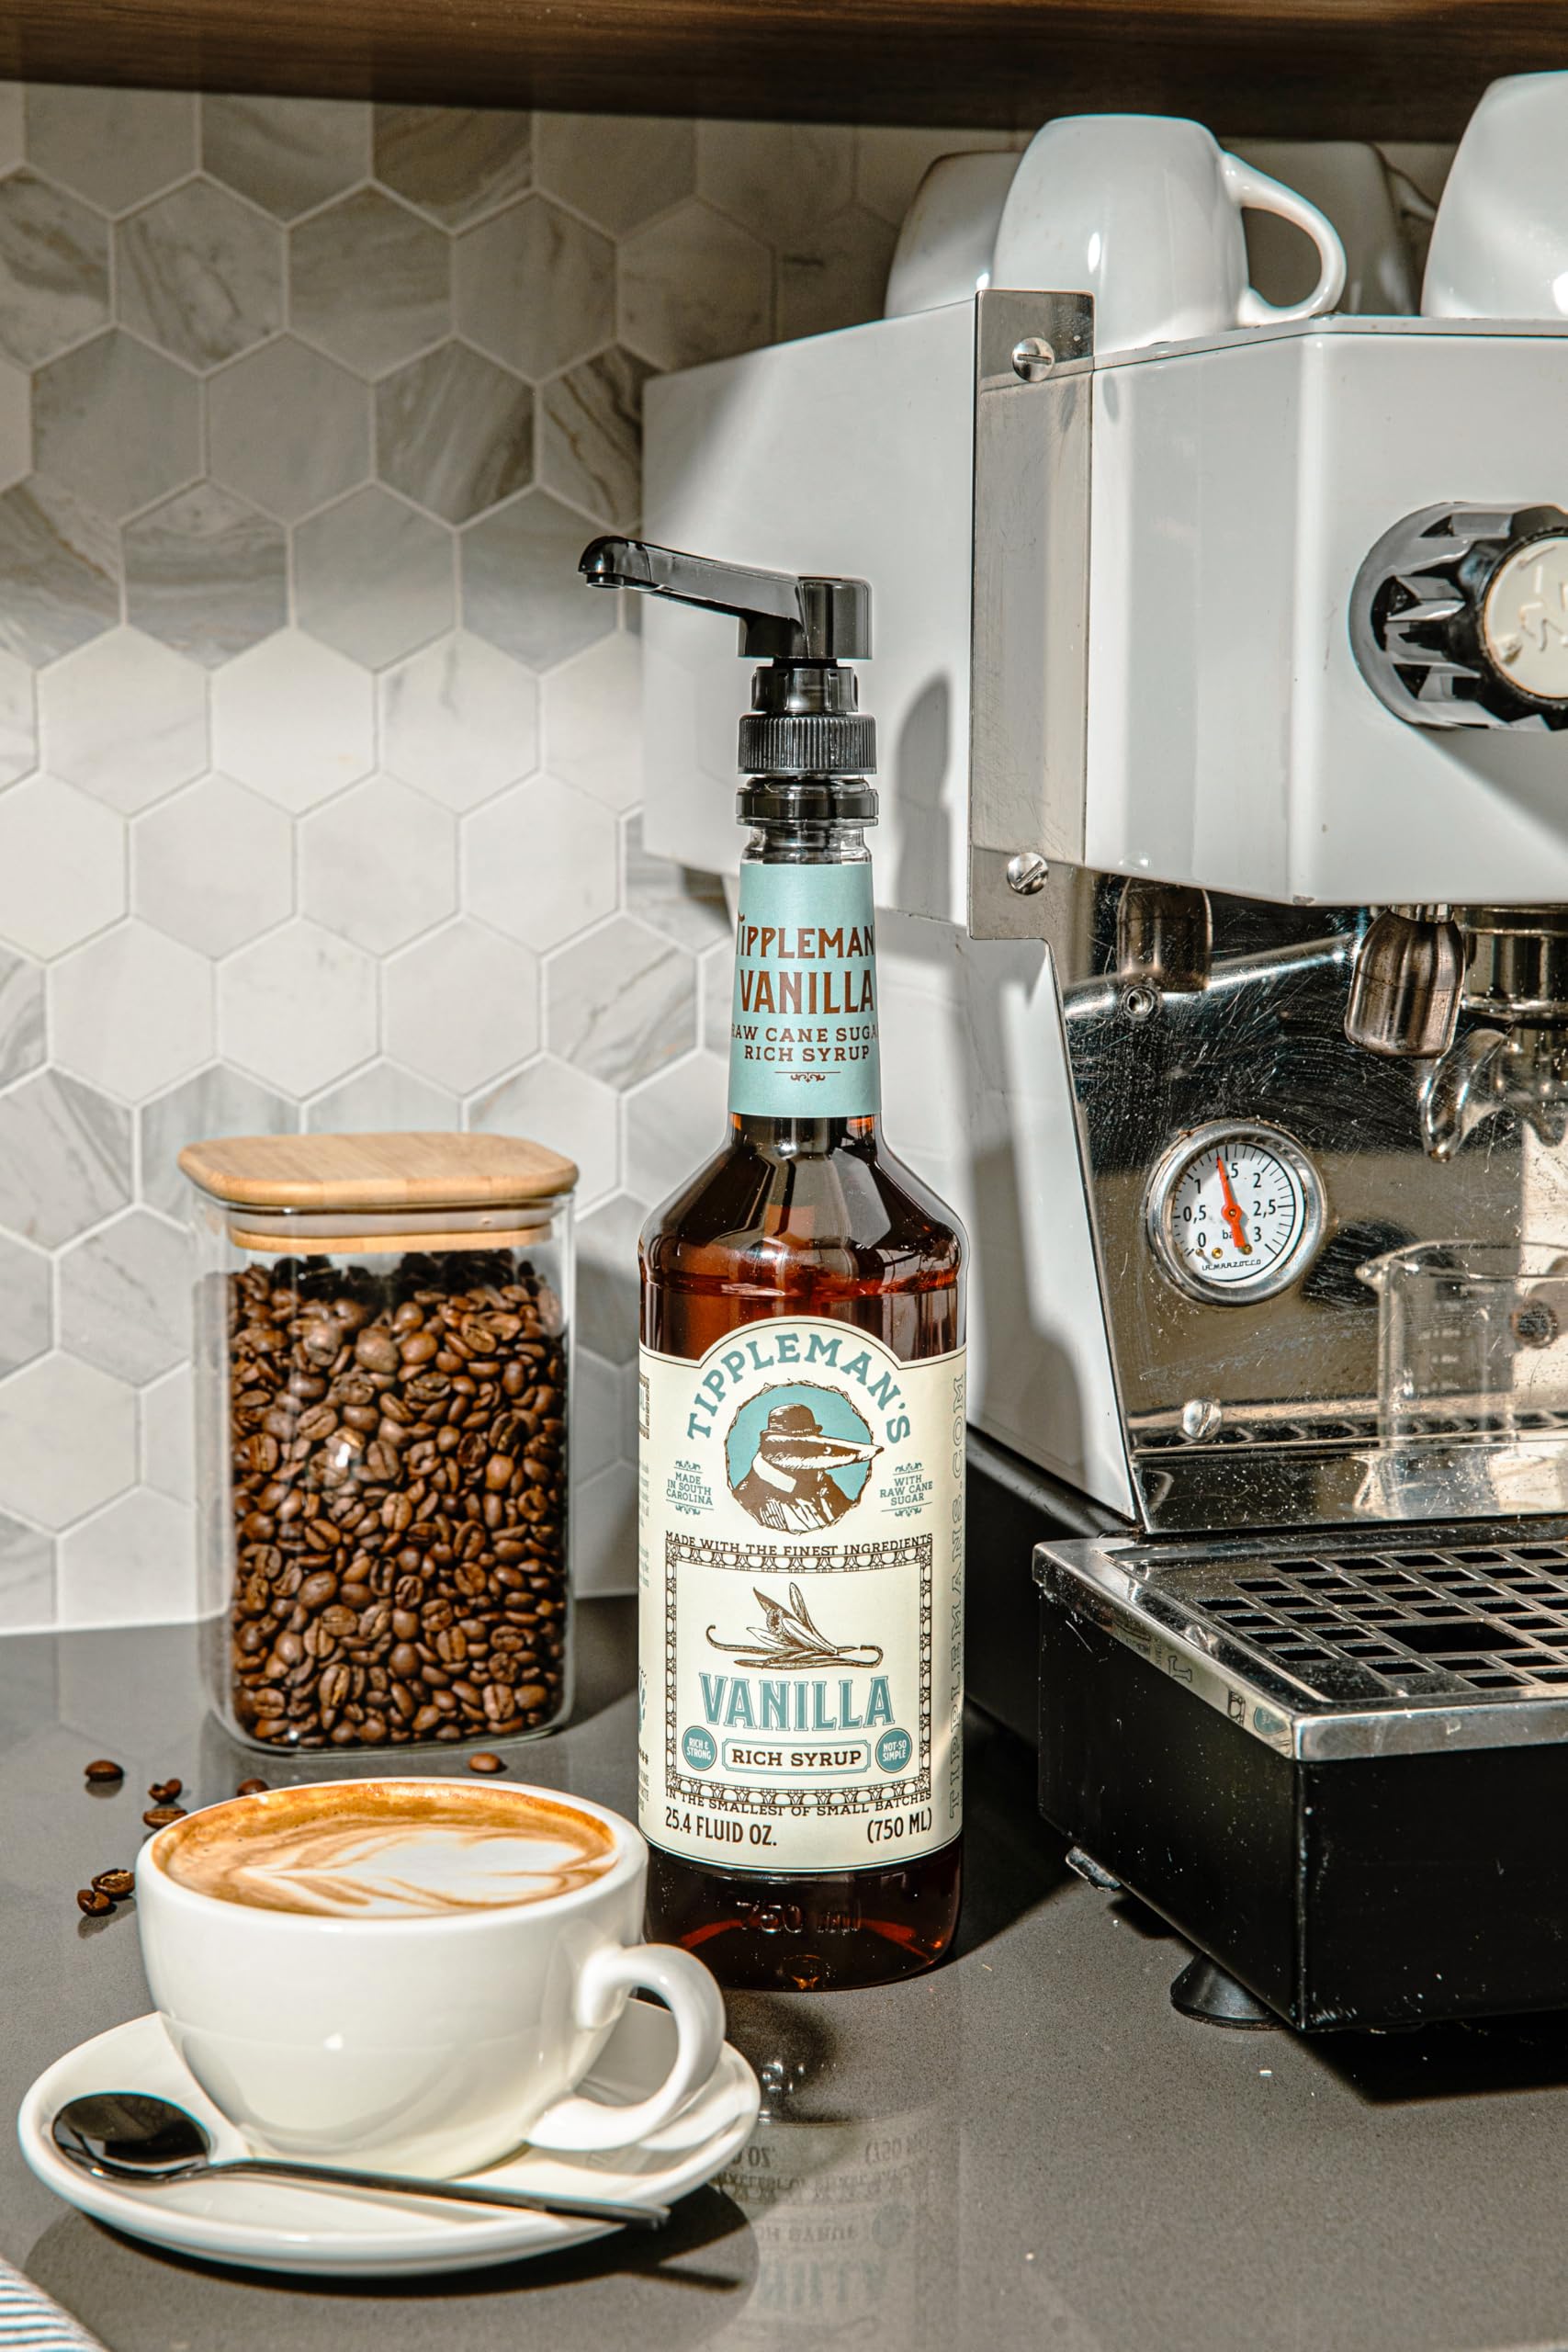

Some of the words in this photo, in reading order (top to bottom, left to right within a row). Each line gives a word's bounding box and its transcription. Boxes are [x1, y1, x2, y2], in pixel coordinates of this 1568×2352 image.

[736, 924, 874, 958] IPPLEMAN
[739, 969, 874, 1014] VANILLA
[765, 1027, 829, 1043] CANE
[745, 1045, 794, 1062] RICH
[803, 1045, 870, 1062] SYRUP
[1194, 1179, 1201, 1194] 1
[1253, 1172, 1262, 1188] 2
[1183, 1204, 1206, 1224] 0,5
[1253, 1199, 1277, 1219] 2,5
[1198, 1232, 1206, 1247] 0
[1222, 1229, 1236, 1239] ba
[1254, 1227, 1262, 1241] 3
[687, 1333, 910, 1443] TIPPLEMAN'S
[675, 1471, 701, 1485] MADE
[895, 1475, 922, 1487] WITH
[667, 1479, 676, 1488] IN
[679, 1482, 712, 1496] SOUTH
[880, 1487, 906, 1498] RAW
[908, 1480, 933, 1494] CANE
[666, 1487, 713, 1506] CAROLINA
[891, 1493, 924, 1506] SUGAR
[665, 1530, 695, 1547] MADE
[700, 1538, 740, 1553] WITH
[746, 1544, 777, 1555] THE
[784, 1545, 838, 1556] FINEST
[844, 1532, 933, 1554] INGREDIENTS
[698, 1672, 896, 1731] VANILLA
[689, 1736, 704, 1749] RICH
[883, 1739, 907, 1752] NOT-SO
[686, 1746, 712, 1760] STRONG
[731, 1748, 783, 1766] RICH
[790, 1750, 862, 1767] SYRUP
[882, 1748, 907, 1762] SIMPLE
[682, 1792, 705, 1807] THE
[709, 1798, 785, 1816] SMALLEST
[791, 1805, 810, 1816] OF
[817, 1804, 869, 1816] SMALL
[874, 1791, 931, 1812] BATCHES
[665, 1806, 692, 1834] 25.4
[696, 1815, 743, 1843] FLUID
[749, 1823, 777, 1846] OZ.
[867, 1816, 904, 1844] (750
[908, 1807, 932, 1835] ML)
